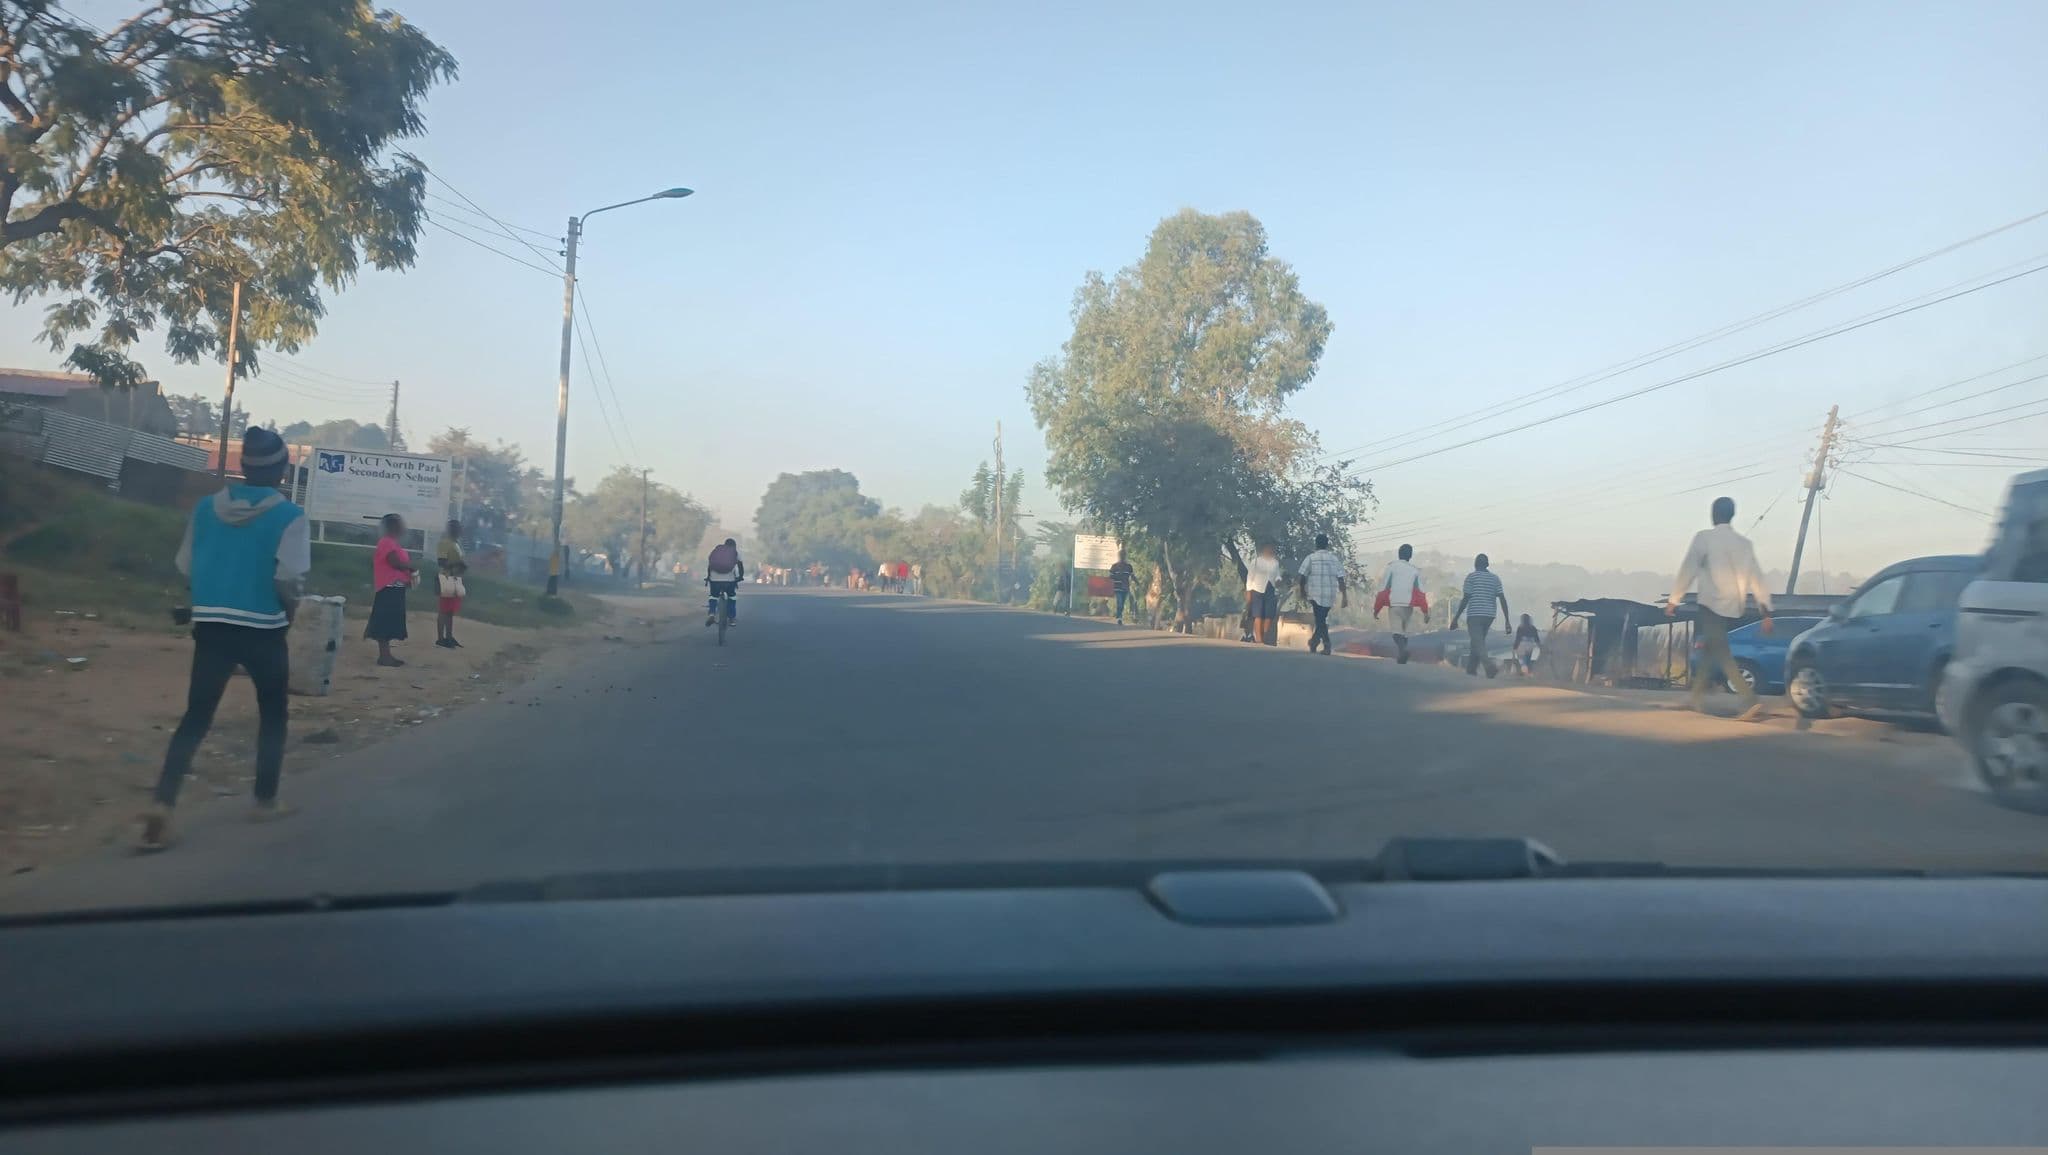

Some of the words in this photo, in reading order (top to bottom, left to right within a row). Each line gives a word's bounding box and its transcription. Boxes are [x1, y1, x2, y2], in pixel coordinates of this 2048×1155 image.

[350, 455, 381, 467] PACT
[384, 458, 415, 470] North
[418, 461, 442, 473] Park
[348, 466, 401, 481] Secondary
[405, 471, 439, 484] School
